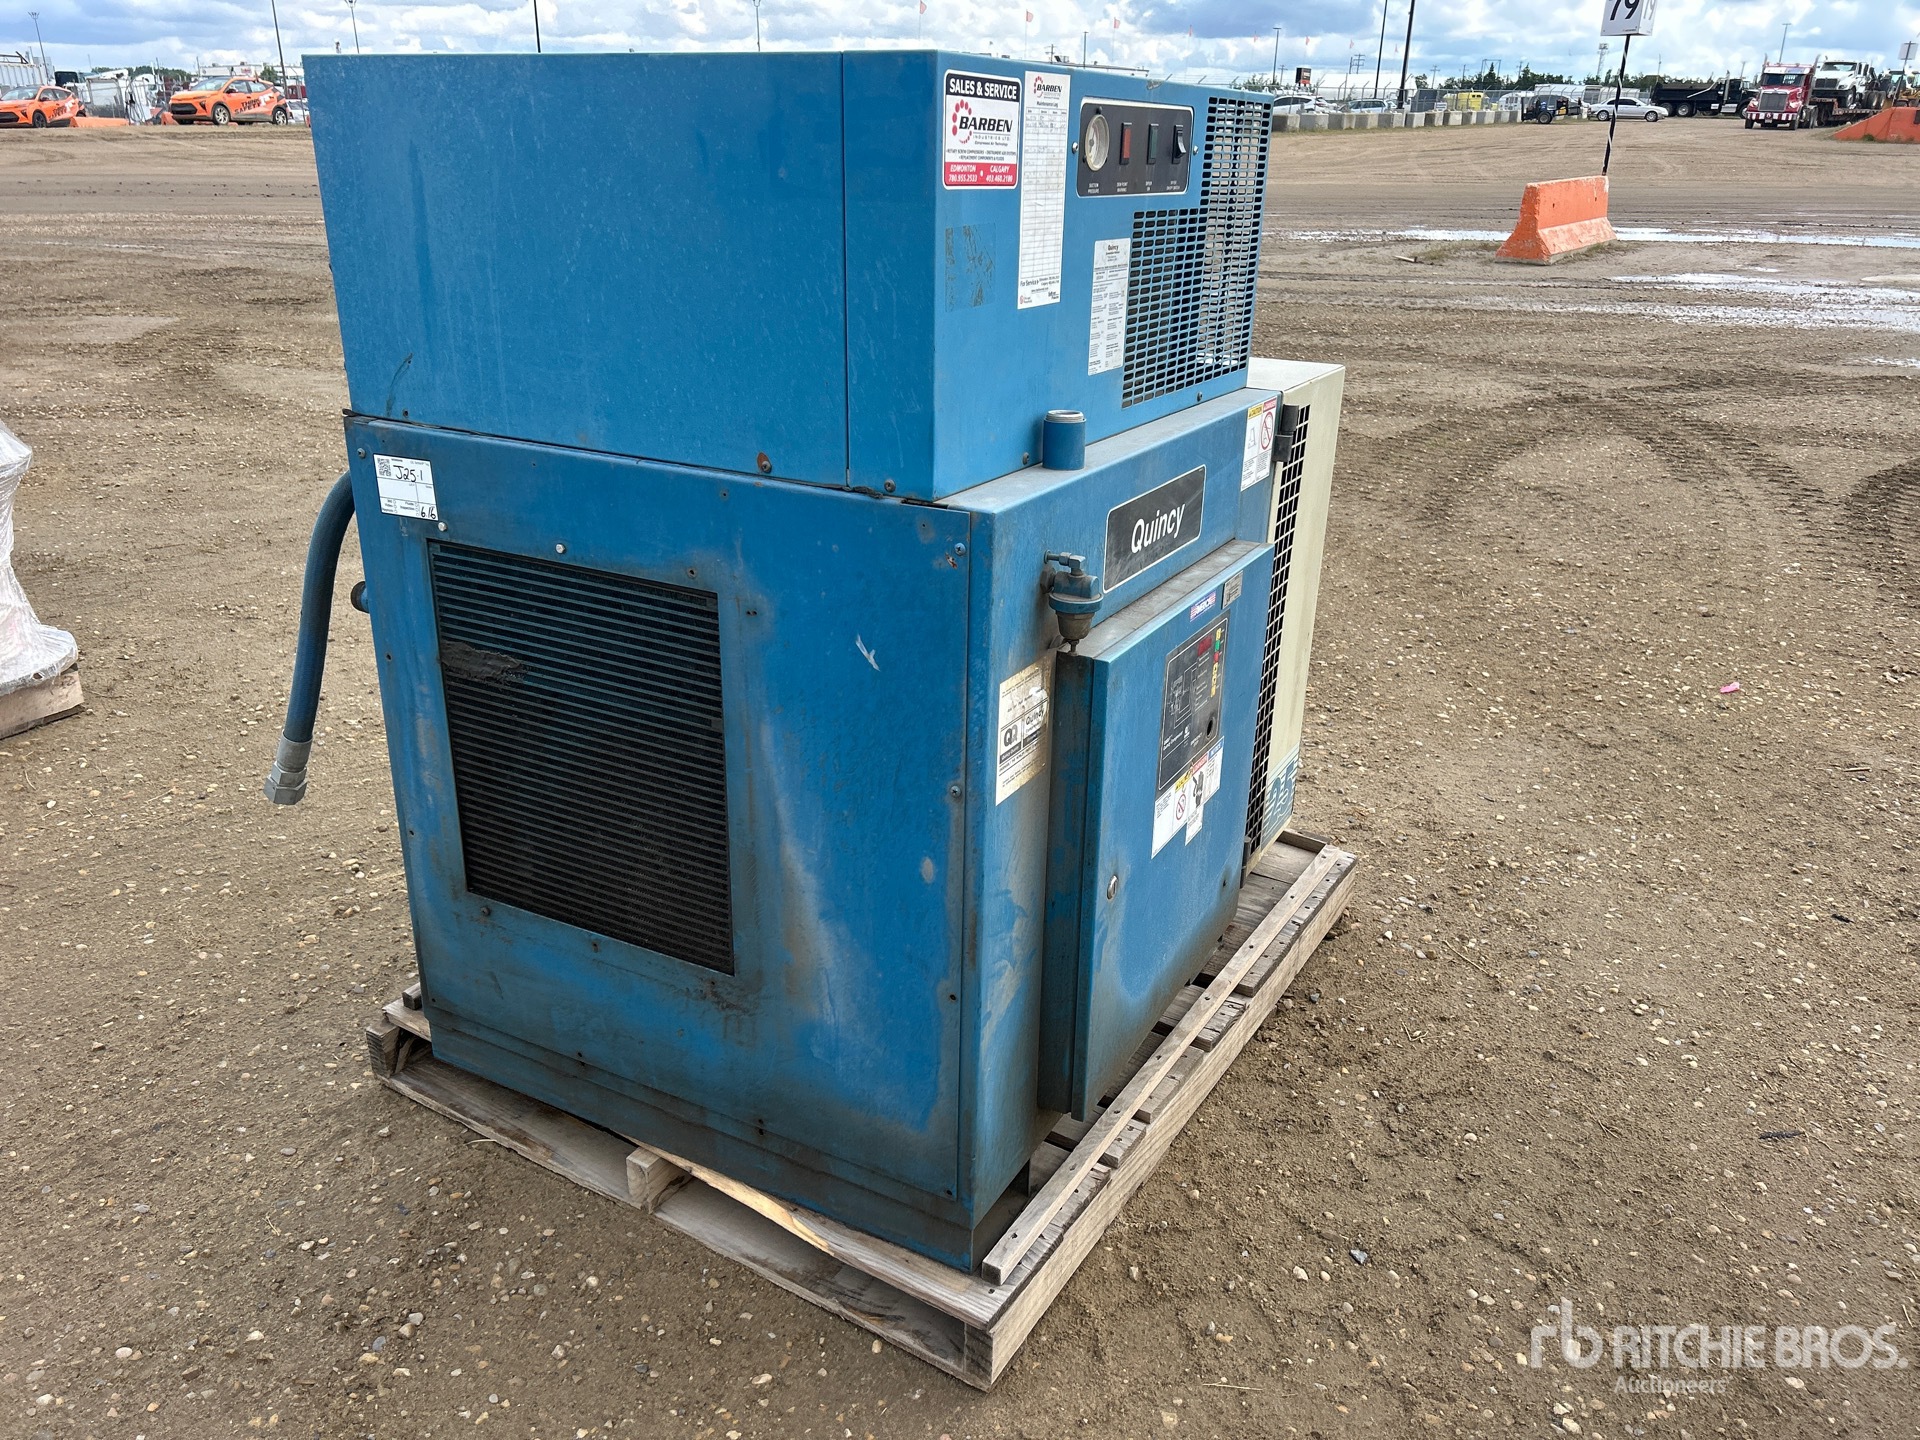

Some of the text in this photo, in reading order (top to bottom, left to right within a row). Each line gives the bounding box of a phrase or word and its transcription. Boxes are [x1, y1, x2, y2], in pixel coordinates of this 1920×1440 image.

[949, 78, 1017, 100] SALES & SERVICE
[1037, 83, 1062, 93] BARBEN
[959, 116, 1013, 133] BARBEN
[950, 164, 977, 173] EDMONTON
[990, 165, 1010, 173] CALGARY
[1131, 503, 1186, 553] Quincy
